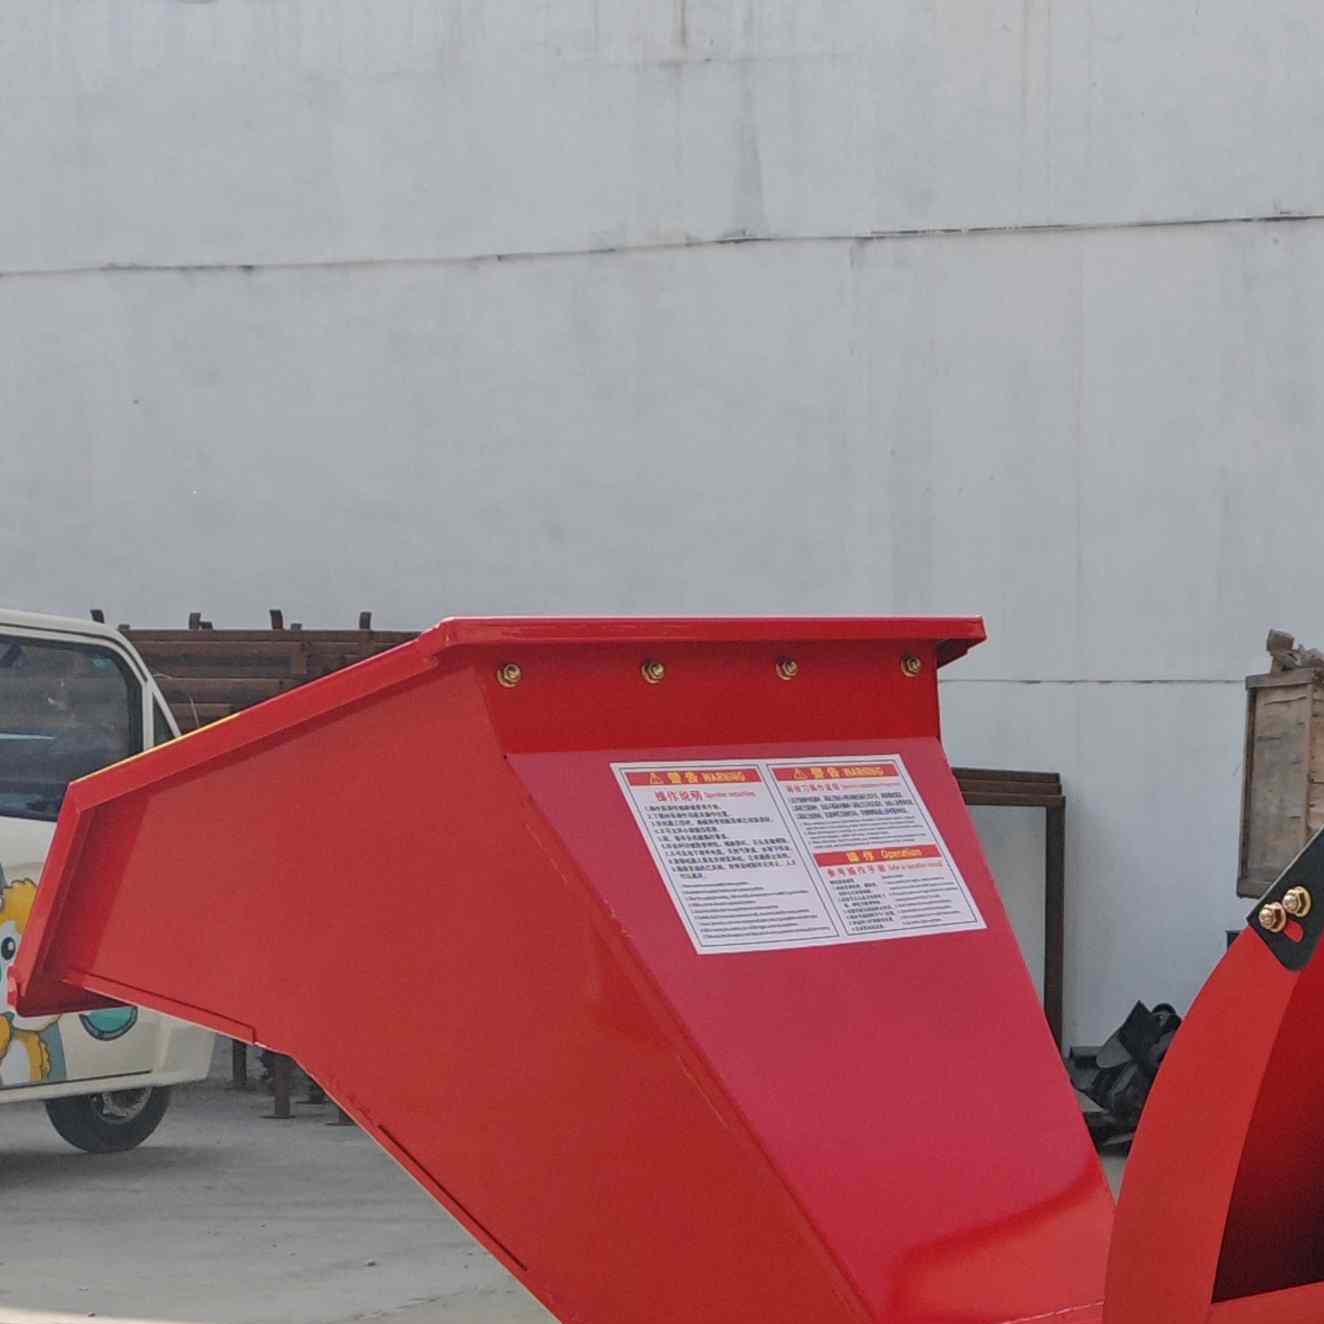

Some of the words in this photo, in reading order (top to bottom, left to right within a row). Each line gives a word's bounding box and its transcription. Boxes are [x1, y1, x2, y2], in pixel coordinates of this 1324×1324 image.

[702, 771, 746, 783] WARNING
[843, 766, 884, 777] WARNING
[880, 848, 923, 859] Operation
